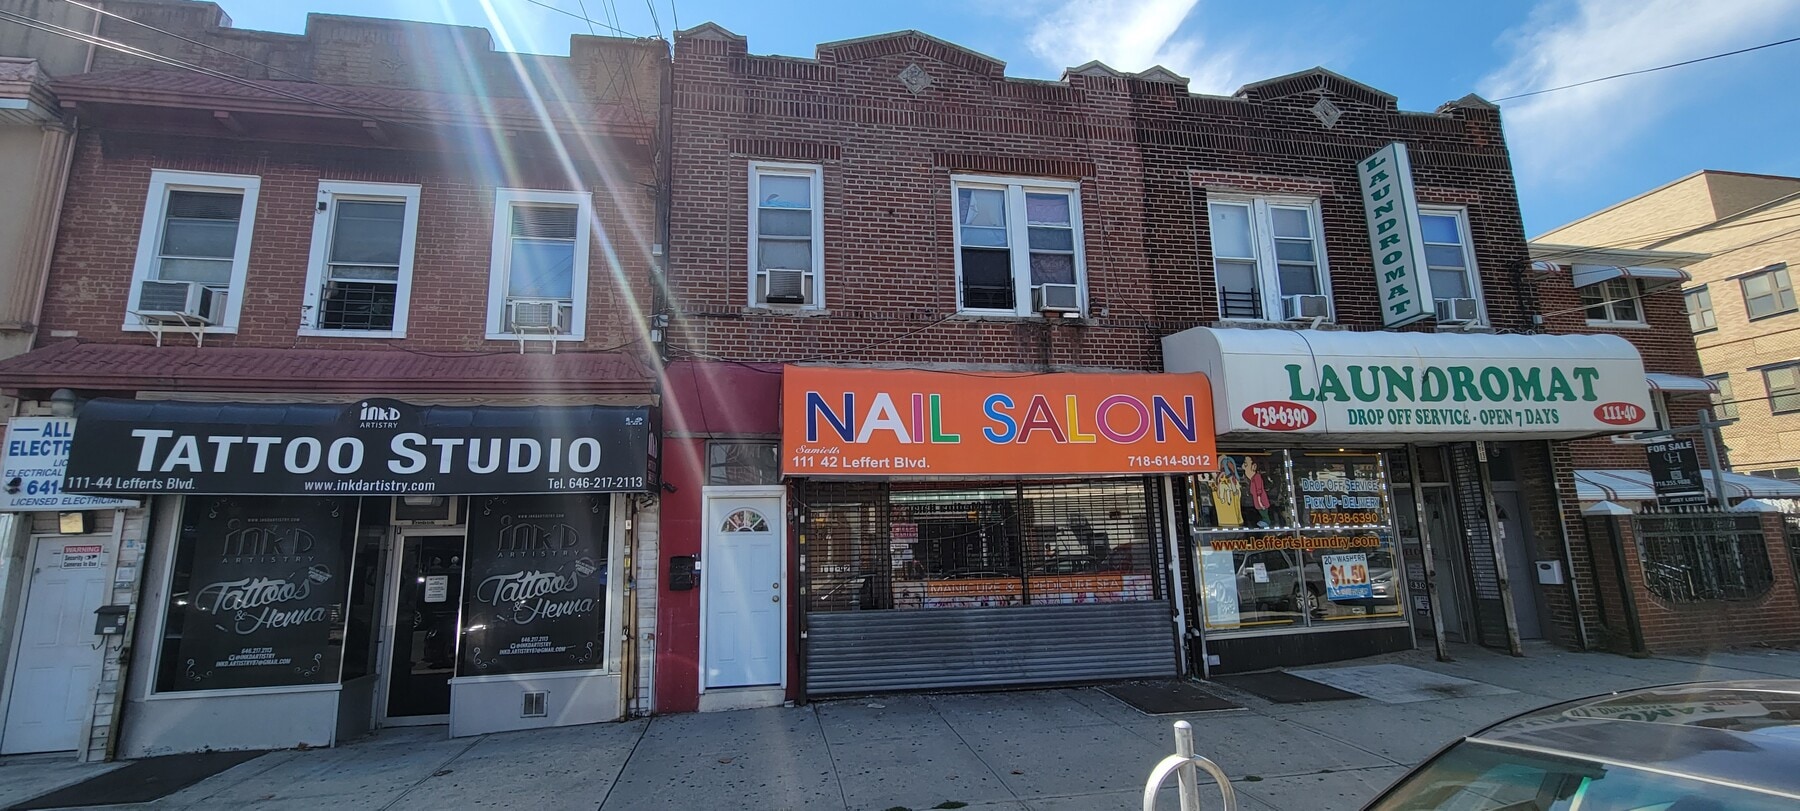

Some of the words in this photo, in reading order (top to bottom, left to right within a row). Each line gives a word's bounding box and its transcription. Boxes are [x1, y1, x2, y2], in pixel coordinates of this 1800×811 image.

[1365, 156, 1411, 316] LAUNDROMAT
[1284, 364, 1600, 402] LAUNDROMAT
[805, 391, 961, 444] NAIL
[982, 392, 1198, 445] SALON
[1253, 406, 1310, 428] 738-6390
[1347, 408, 1384, 425] DROP
[1387, 408, 1413, 425] OFF
[1415, 408, 1471, 426] SERVICE
[1479, 408, 1515, 426] OPEN
[1515, 411, 1523, 428] 7
[1523, 408, 1560, 425] DAYS
[1602, 405, 1637, 421] 111-40
[42, 421, 72, 438] ALL
[131, 429, 365, 474] TATTOO
[387, 432, 602, 474] STUDIO
[1647, 444, 1667, 454] FOR
[1668, 441, 1693, 451] SALE
[792, 456, 814, 468] 111
[820, 456, 838, 468] 42
[842, 456, 890, 468] Leffert
[894, 456, 931, 468] Blvd.
[1128, 455, 1211, 467] 718-614-8012
[5, 469, 63, 477] ELECTRICAL
[67, 477, 113, 489] 111-44
[116, 477, 164, 490] Lefferts
[166, 477, 196, 490] Blvd.
[304, 480, 436, 493] www.inkdartistry.com
[548, 478, 566, 489] Tel.
[568, 476, 643, 489] 646-217-2113
[1301, 478, 1326, 491] DROP
[1327, 478, 1345, 491] OFF
[1345, 478, 1379, 492] SERVICE
[10, 498, 58, 506] LICENSED
[1304, 494, 1325, 509] PICK
[1310, 511, 1378, 524] 718-738-6390
[1210, 535, 1381, 551] www.leffertslaundry.com
[497, 550, 580, 558] ARTISTRY
[1324, 555, 1332, 565] 20
[1336, 553, 1366, 563] WASHERS
[1329, 564, 1367, 587] $1.50
[513, 597, 594, 624] Henna
[235, 606, 326, 634] Henna
